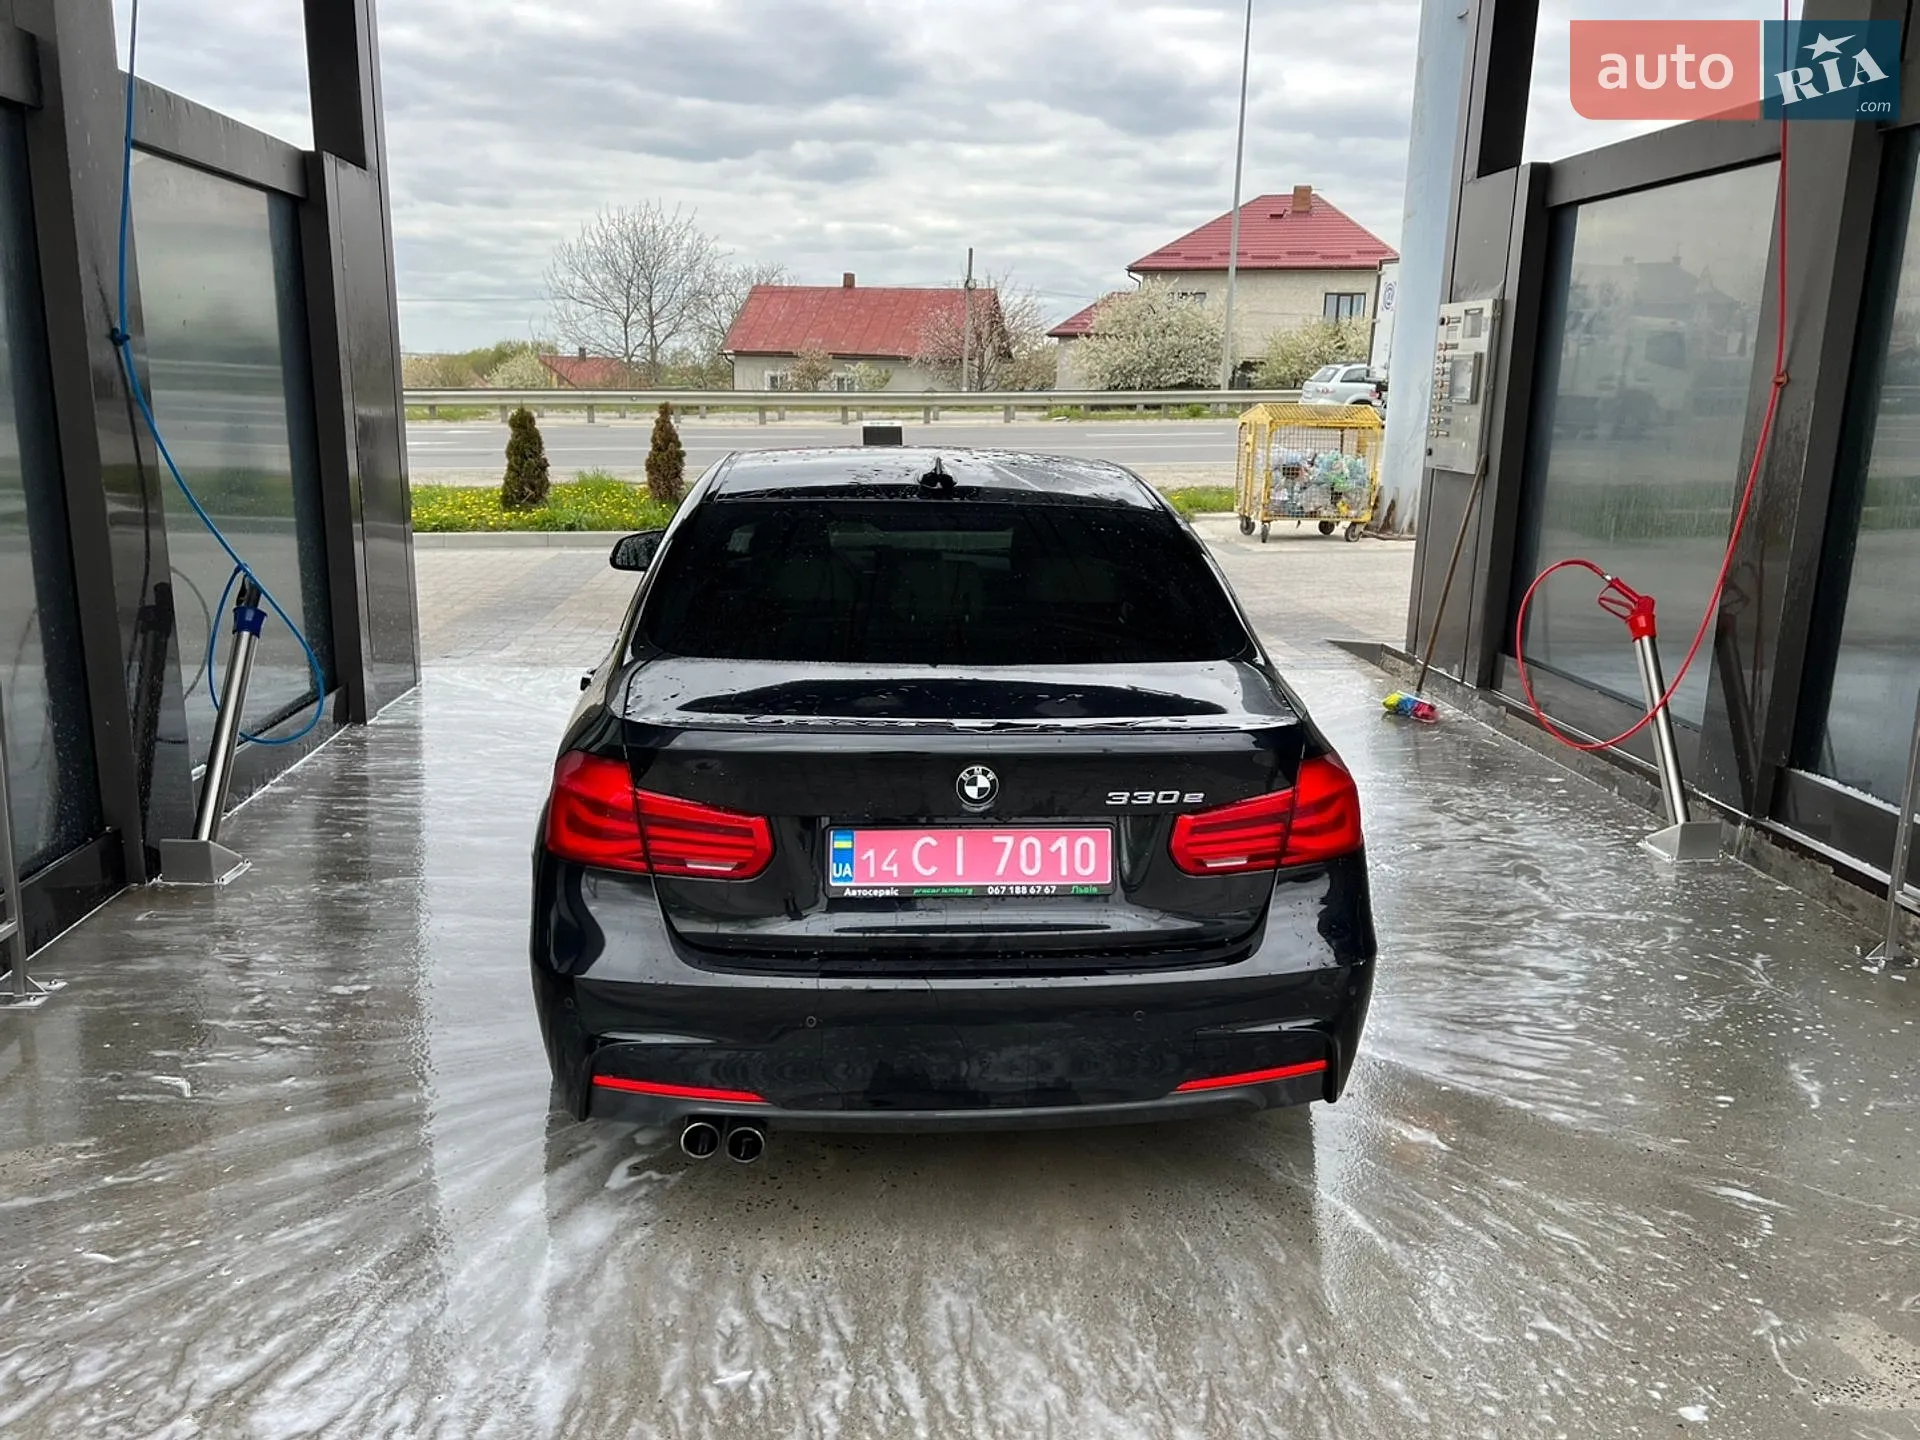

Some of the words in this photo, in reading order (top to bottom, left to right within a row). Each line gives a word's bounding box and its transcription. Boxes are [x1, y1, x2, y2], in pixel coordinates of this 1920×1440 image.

[1105, 790, 1205, 805] 330e
[861, 849, 899, 878] 14
[992, 836, 1096, 877] 7010
[833, 863, 852, 878] UA
[843, 886, 899, 898] Автосервіс
[987, 885, 1006, 895] 067
[1009, 885, 1028, 895] 188
[1029, 885, 1042, 895] 67
[1043, 885, 1057, 895] 67
